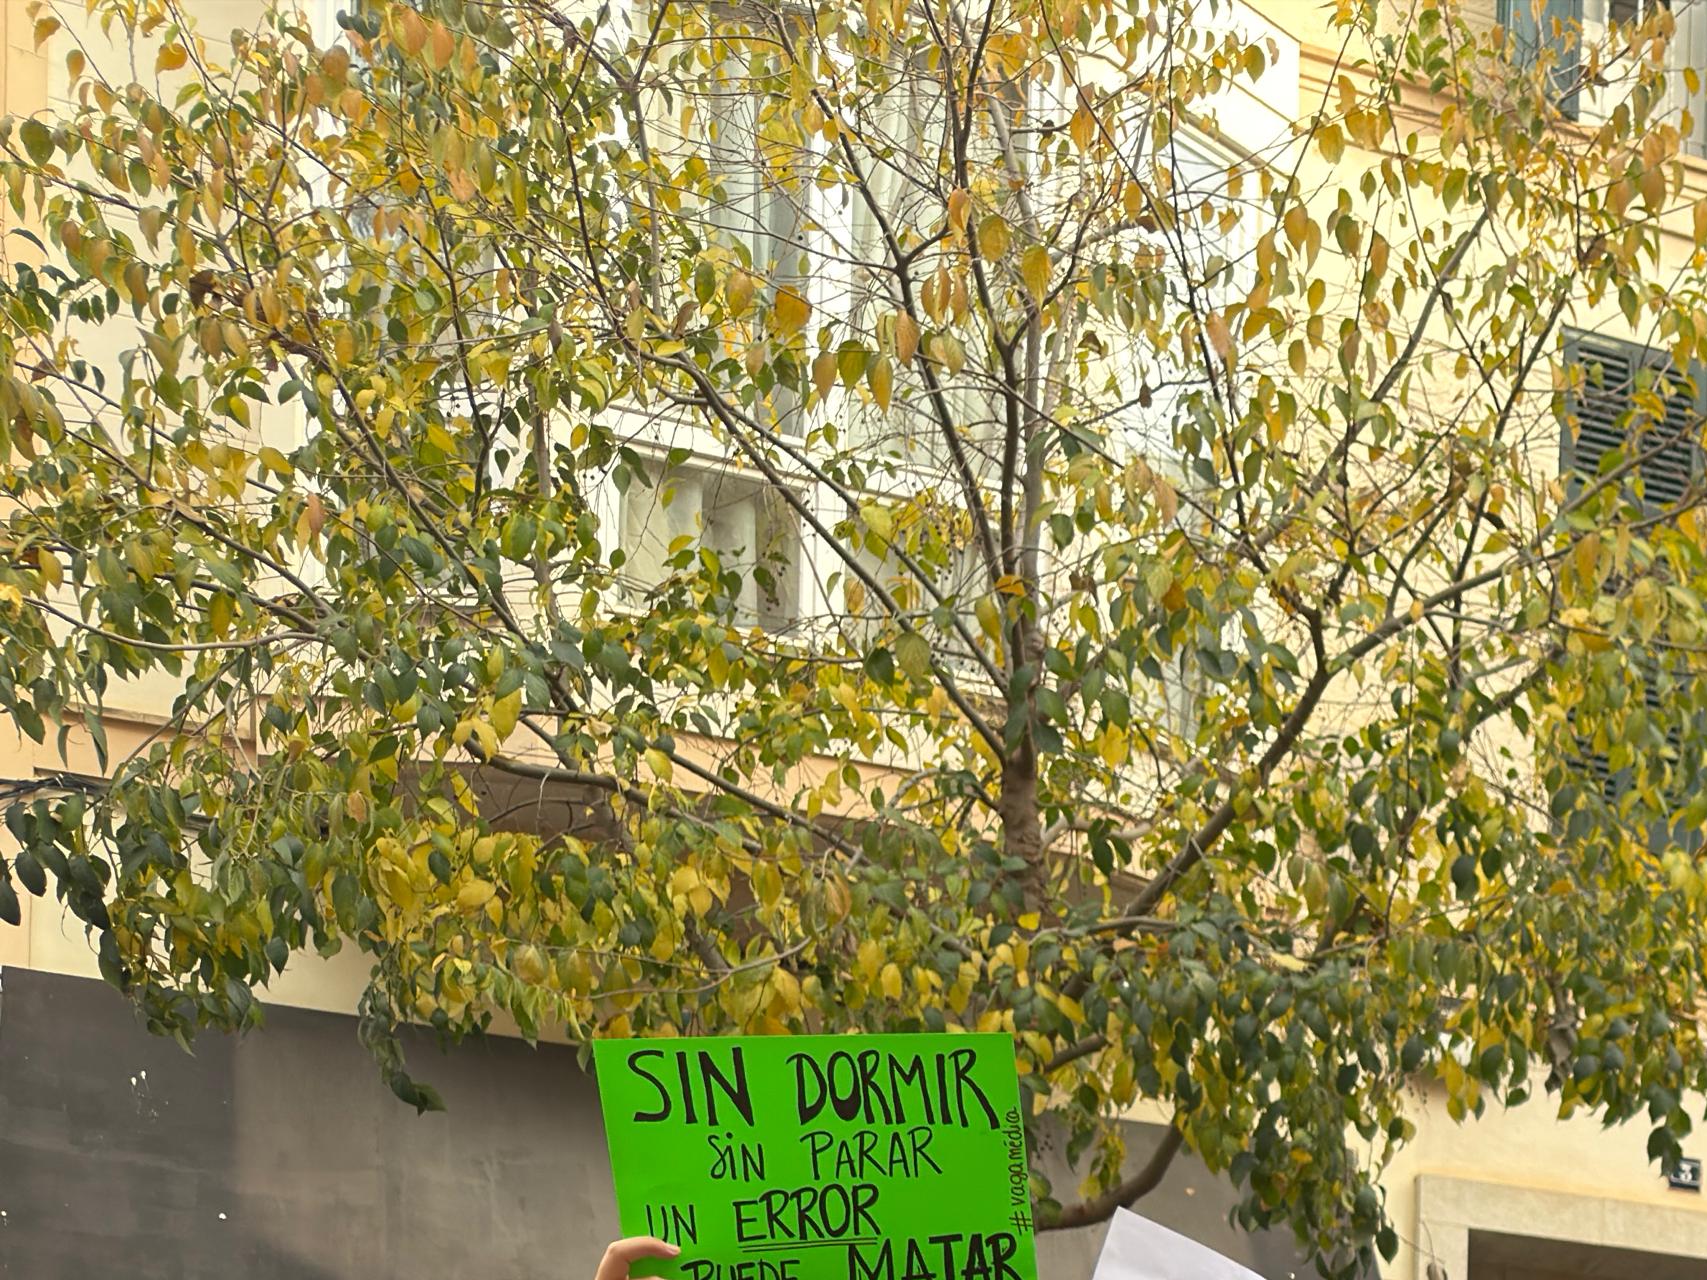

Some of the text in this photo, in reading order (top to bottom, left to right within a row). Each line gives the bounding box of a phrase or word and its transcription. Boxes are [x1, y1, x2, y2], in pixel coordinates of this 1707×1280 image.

[627, 1046, 1001, 1131] SIN DORMIR
[646, 1183, 881, 1246] UN ERROR
